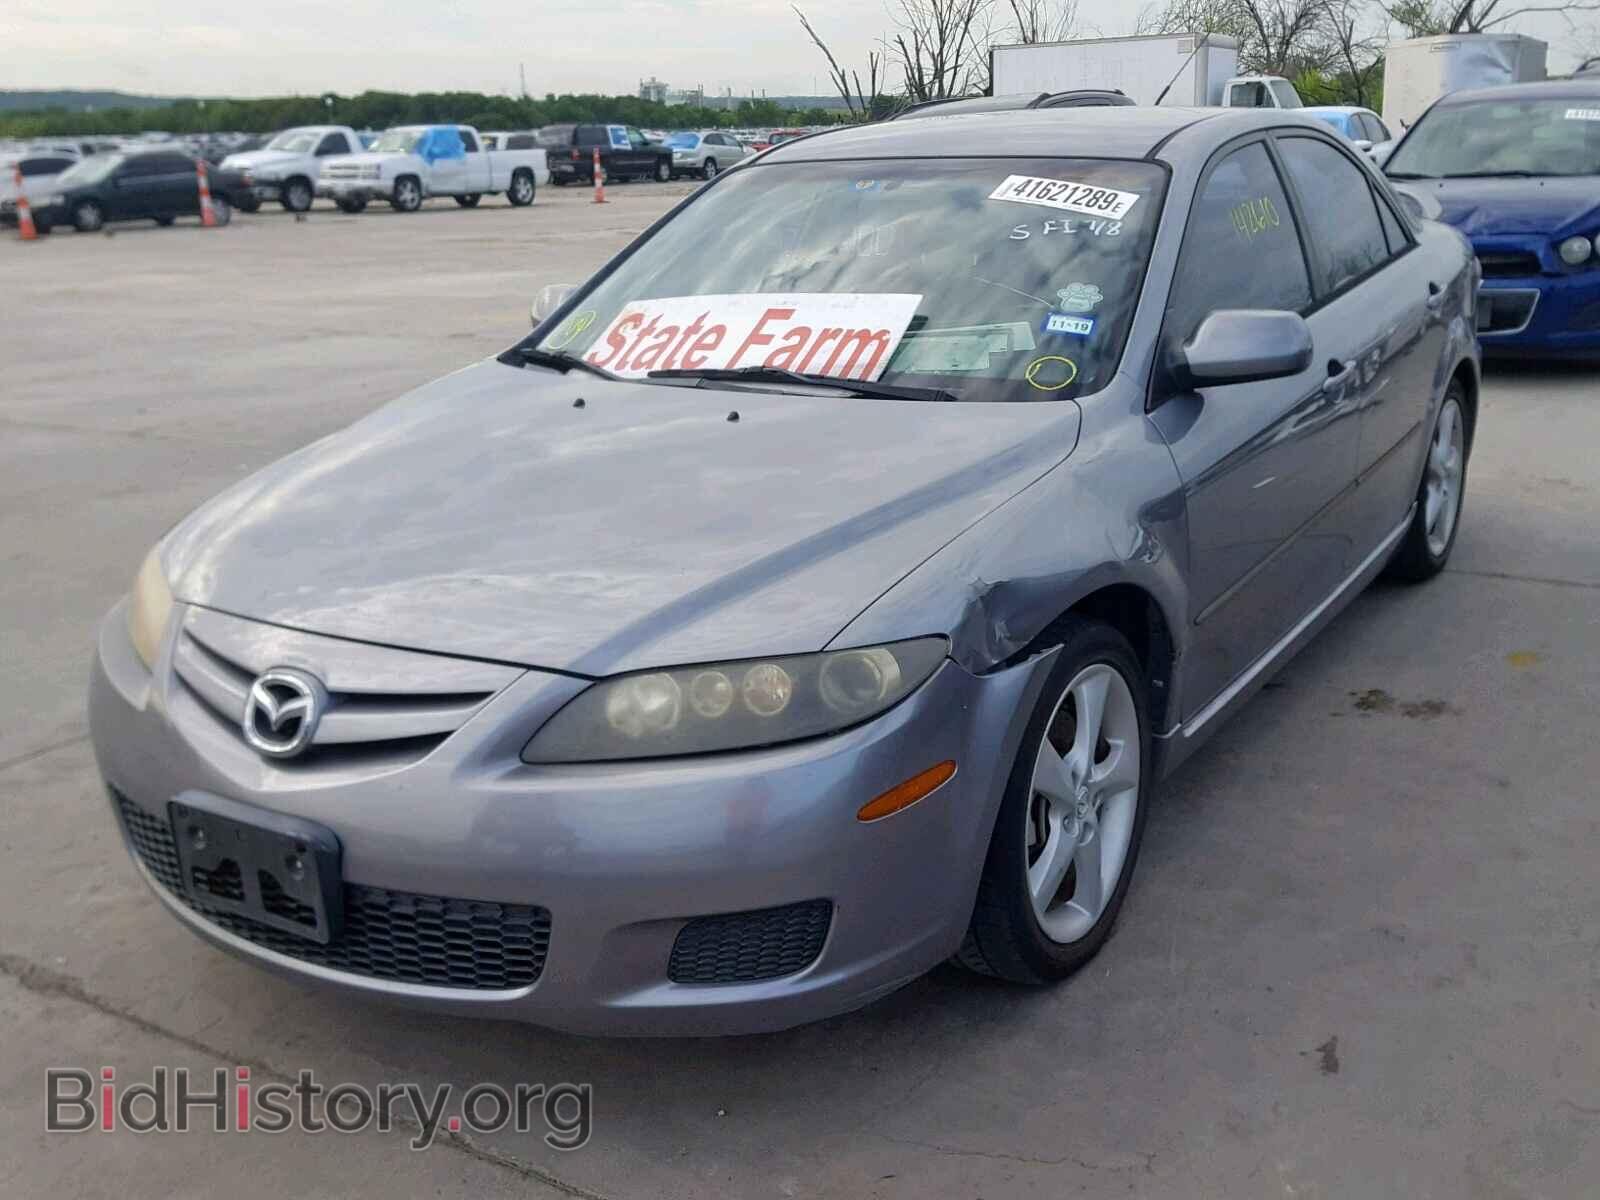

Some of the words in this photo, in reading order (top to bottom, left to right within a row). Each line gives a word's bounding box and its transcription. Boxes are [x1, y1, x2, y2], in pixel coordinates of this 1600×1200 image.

[587, 308, 728, 371] State
[727, 307, 892, 382] Farm
[1051, 319, 1089, 332] 11-19
